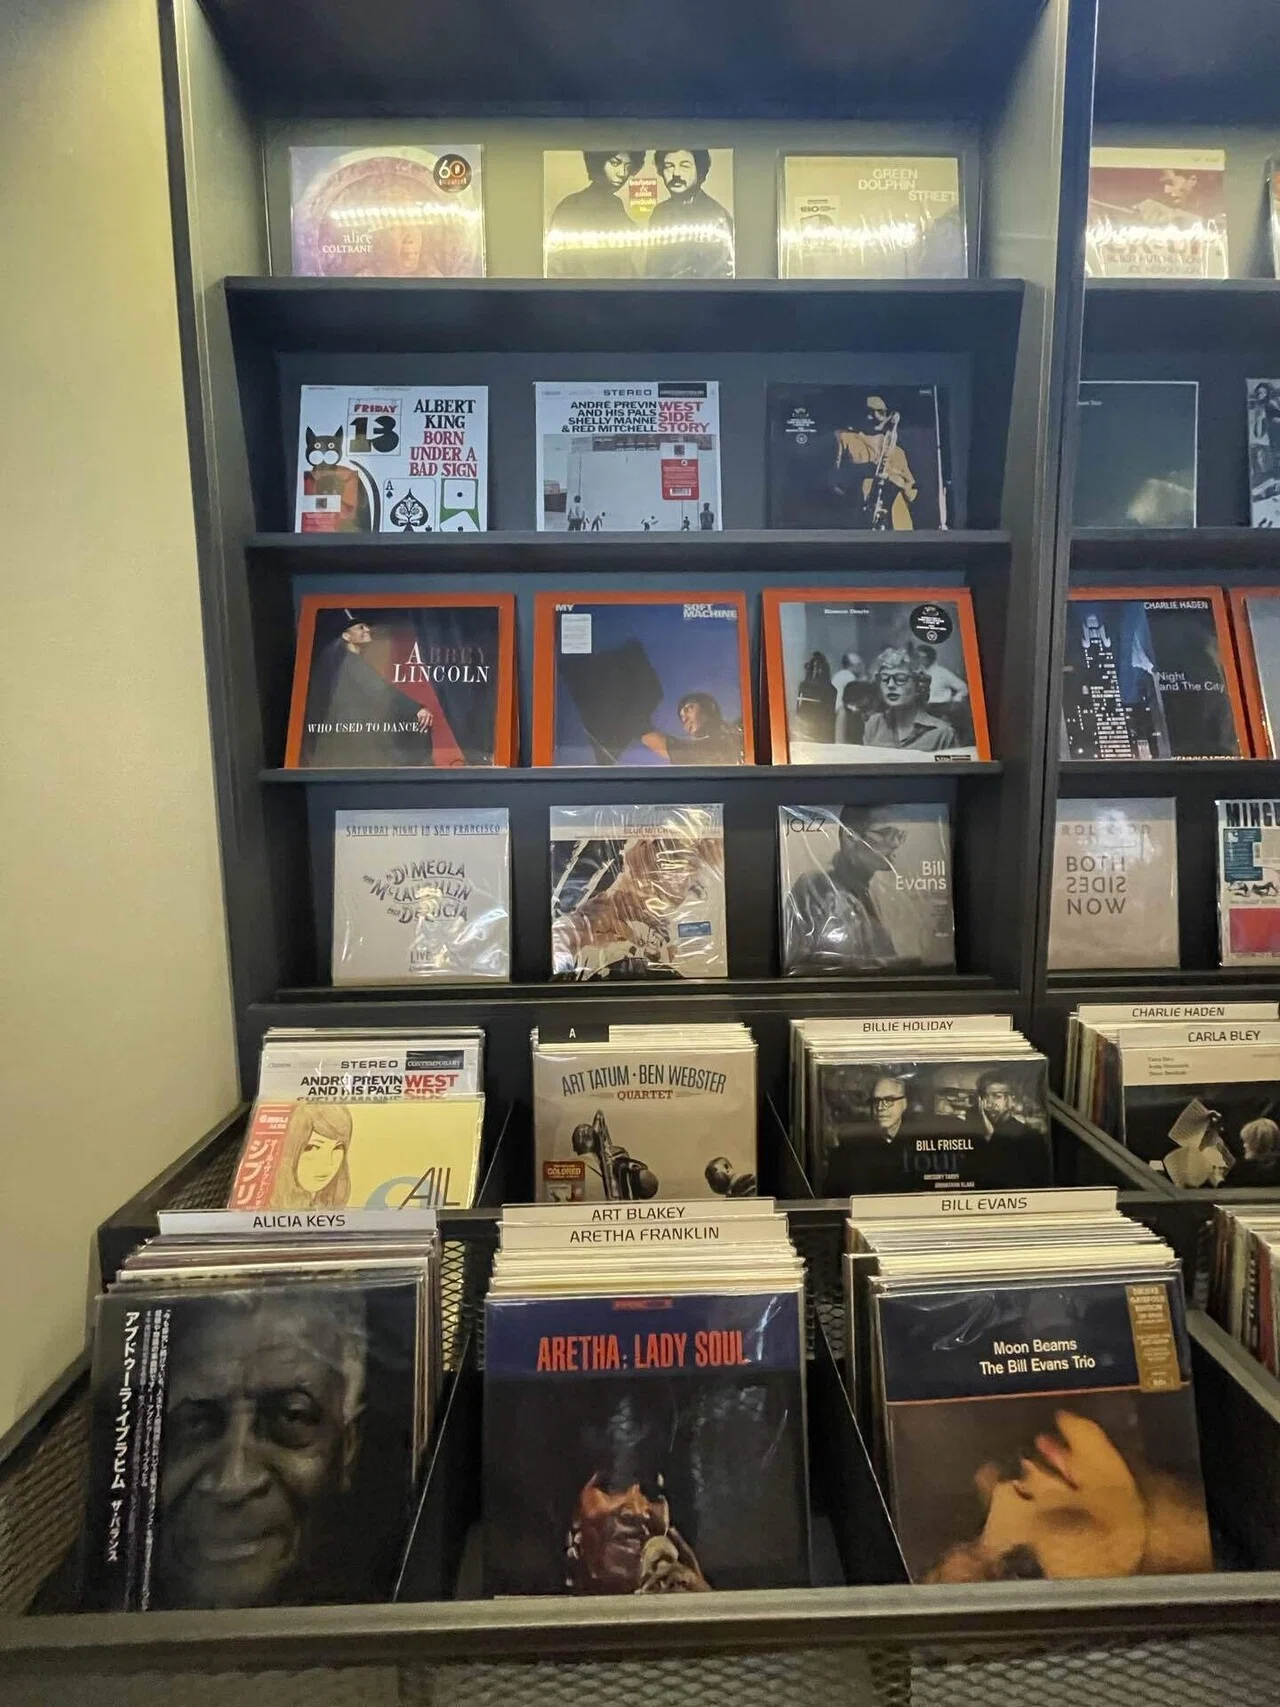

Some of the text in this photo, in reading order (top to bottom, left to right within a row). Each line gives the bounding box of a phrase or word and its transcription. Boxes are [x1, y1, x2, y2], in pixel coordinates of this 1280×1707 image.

[439, 159, 466, 178] 60
[872, 168, 918, 179] GREEN
[858, 179, 916, 190] DOLPHIN
[908, 190, 956, 202] STREET
[603, 389, 652, 397] STEREO
[354, 404, 398, 413] FRIDAY
[413, 398, 476, 414] ALBERT
[614, 401, 657, 409] PREVIN
[658, 401, 703, 412] WEST
[577, 409, 657, 417] AND HIS PALS
[658, 412, 695, 422] SIDE
[424, 414, 466, 429] KING
[568, 417, 657, 425] SHELLY MANNE
[561, 425, 657, 433] & RED MITCHELL
[658, 422, 710, 433] STORY
[349, 415, 400, 453] 13
[423, 430, 465, 445] BORN
[409, 446, 477, 461] UNDER A
[409, 463, 478, 478] BAD SIGN
[385, 480, 394, 491] A
[555, 604, 574, 612] MY
[1144, 601, 1178, 610] CHARLIE
[683, 610, 738, 618] MACHINE
[392, 664, 490, 683] LINCOLN
[1158, 672, 1186, 683] Night
[1158, 682, 1226, 693] and The City
[307, 723, 333, 733] WHO
[335, 722, 364, 733] USED
[366, 722, 381, 733] TO
[346, 825, 389, 837] SATURDAY
[393, 825, 418, 836] NIGHT
[434, 825, 450, 836] SAN
[454, 823, 501, 836] FRANCISCO
[785, 817, 827, 837] jazz
[411, 860, 465, 879] MEOLA
[922, 861, 946, 876] Bill
[1066, 856, 1125, 872] BOTH
[895, 876, 947, 890] Evans
[1067, 898, 1126, 915] NOW
[1131, 1007, 1225, 1018] CHARLIE HADEN
[862, 1020, 954, 1032] BILLIE HOLIDAY
[569, 1028, 577, 1039] A
[1187, 1030, 1261, 1043] CARLA BLEY
[340, 1060, 399, 1069] STEREO
[352, 1075, 404, 1085] PREVIN
[404, 1074, 459, 1088] WEST
[561, 1071, 586, 1097] ART
[587, 1065, 630, 1089] TATUM
[639, 1064, 665, 1085] BEN
[668, 1067, 728, 1095] WEBSTER
[307, 1086, 338, 1095] AND
[368, 1085, 402, 1095] PALS
[617, 1090, 674, 1101] QUARTET
[915, 1138, 975, 1152] BILL FRISELL
[941, 1197, 1028, 1212] BILL EVANS
[591, 1206, 686, 1222] ART BLAKEY
[253, 1214, 346, 1229] ALICIA KEYS
[569, 1226, 720, 1244] ARETHA FRANKLIN
[537, 1330, 749, 1373] ARETHA: LADY SOUL
[994, 1338, 1077, 1355] Moon Beams
[979, 1354, 1097, 1376] The Bill Evans Trio
